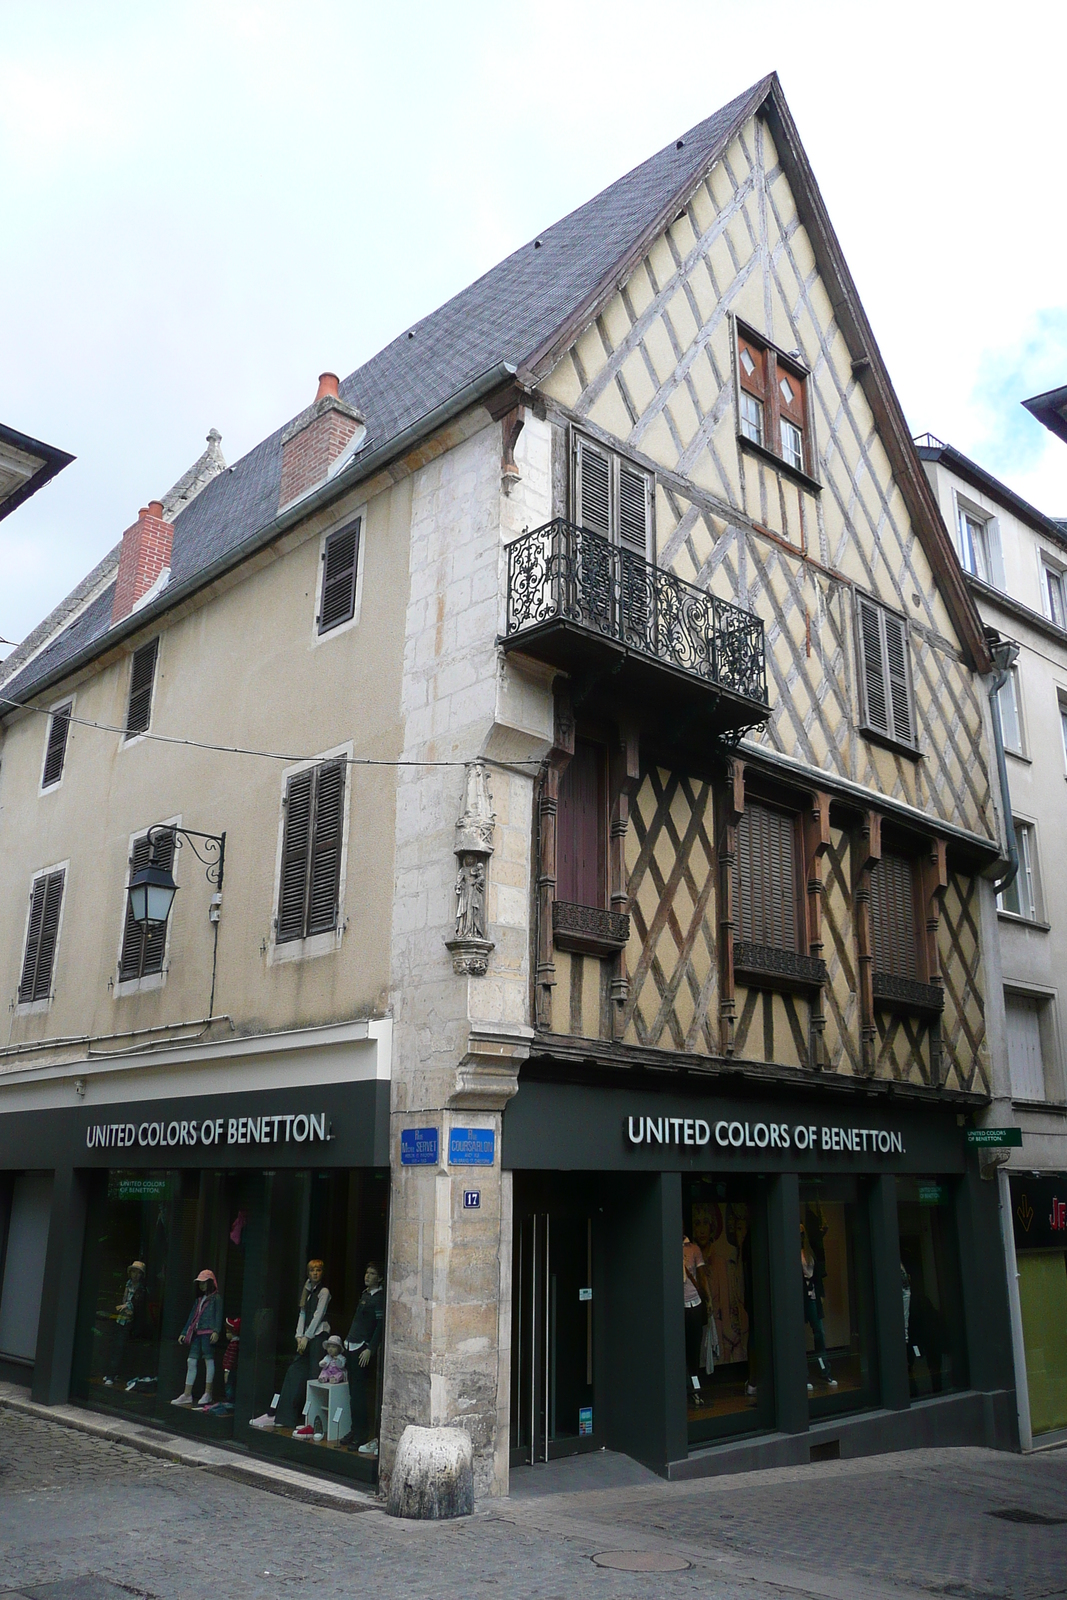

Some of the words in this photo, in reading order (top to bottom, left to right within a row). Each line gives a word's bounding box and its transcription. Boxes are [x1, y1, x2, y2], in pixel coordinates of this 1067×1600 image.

[86, 1124, 136, 1148] UNITED
[138, 1120, 197, 1146] COLORS
[201, 1119, 224, 1145] OF
[227, 1112, 331, 1144] BENETTON.
[628, 1116, 711, 1145] UNITED
[714, 1120, 790, 1148] COLORS
[794, 1125, 818, 1150] OF
[822, 1126, 906, 1154] BENETTON.
[416, 1140, 437, 1153] SERVET
[142, 1180, 166, 1188] COLORS
[467, 1194, 478, 1205] 17
